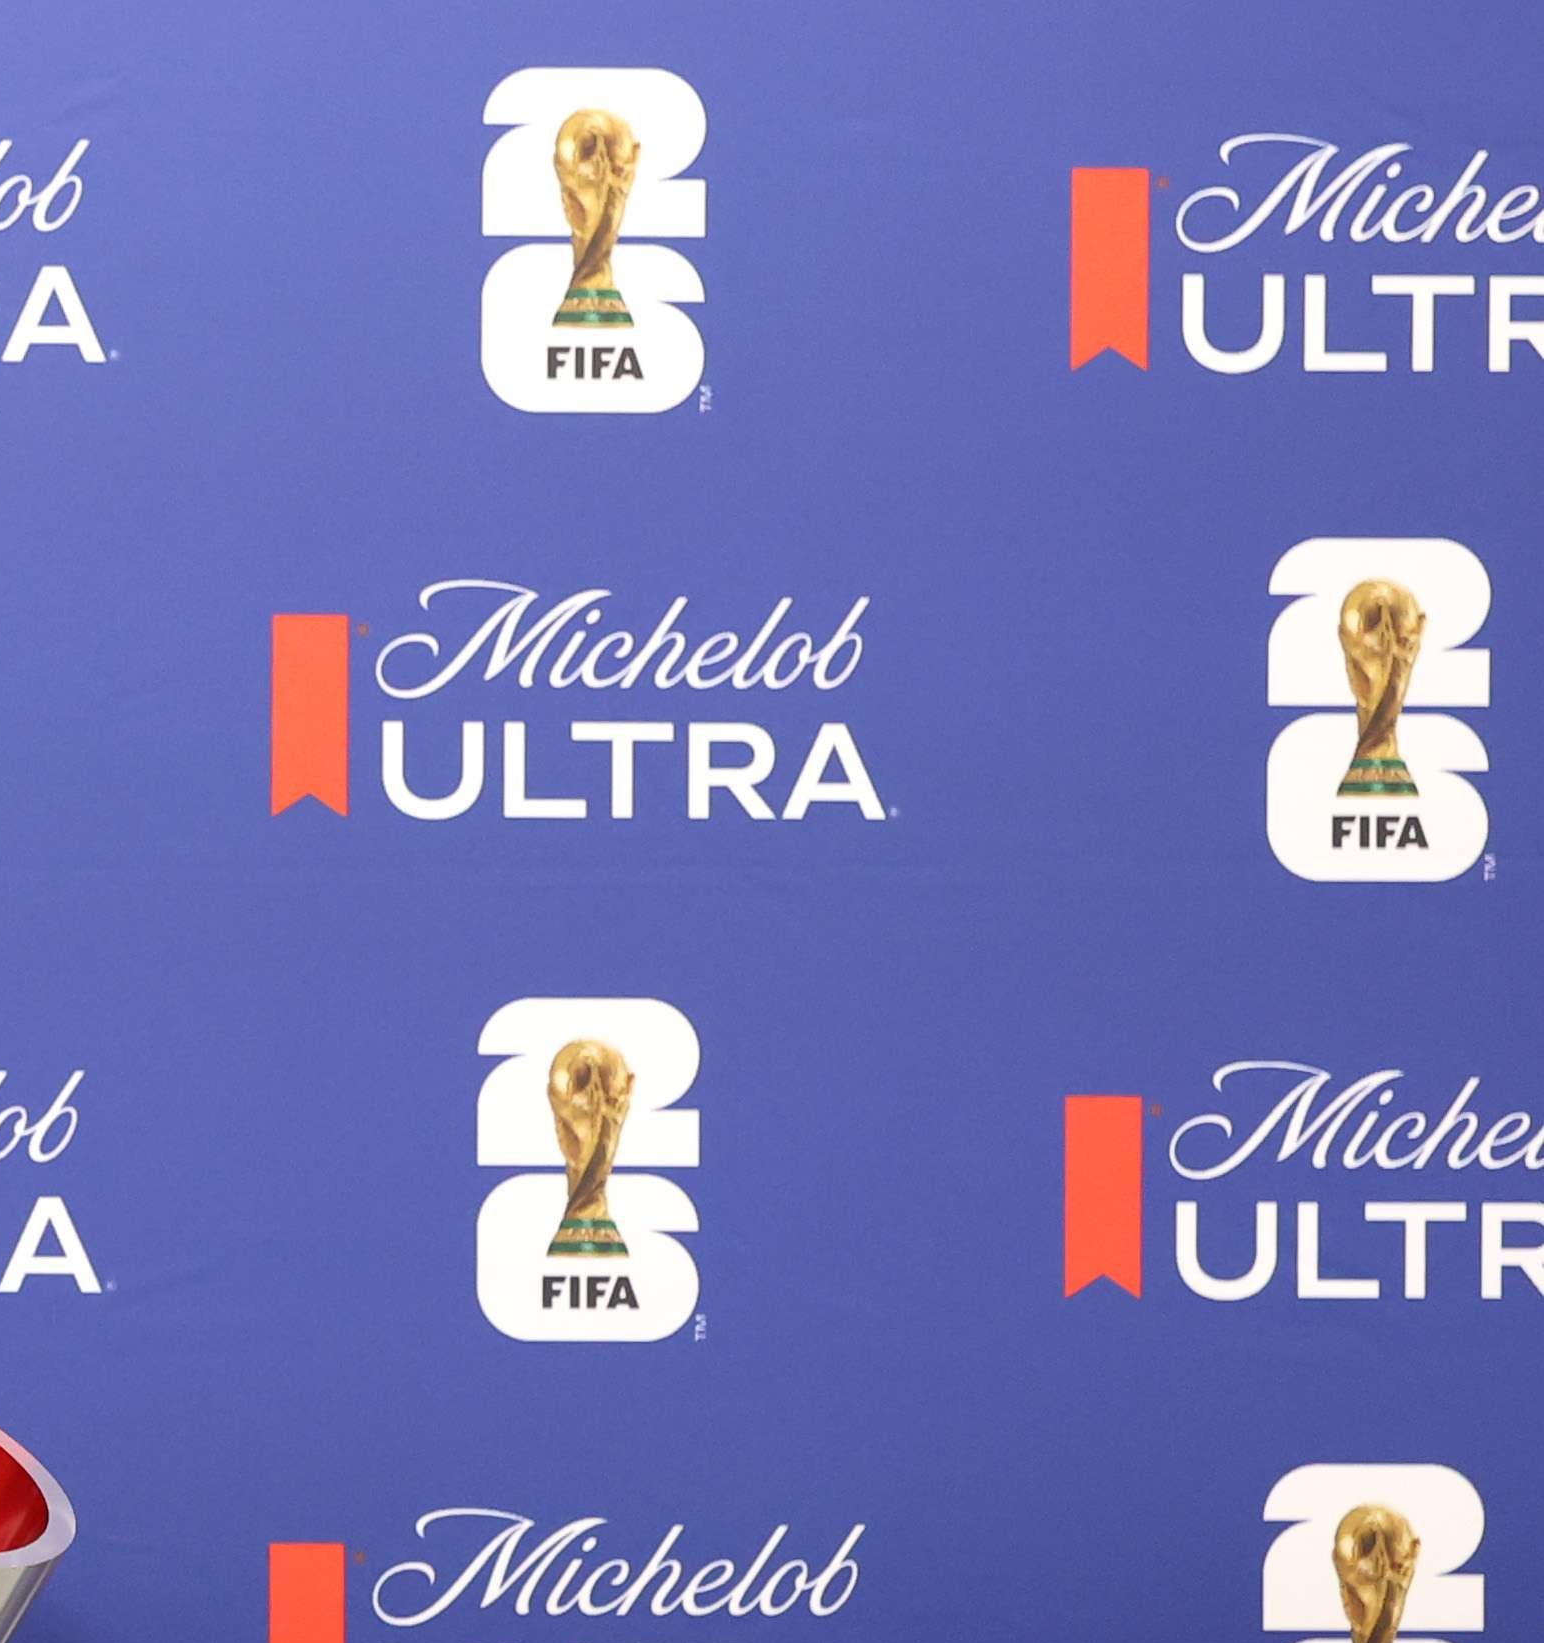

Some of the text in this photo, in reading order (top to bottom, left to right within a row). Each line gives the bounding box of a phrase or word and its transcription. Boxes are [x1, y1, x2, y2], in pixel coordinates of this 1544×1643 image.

[548, 348, 642, 378] FIFA
[375, 579, 870, 699] Michelob
[382, 720, 886, 820] ULTRA
[1333, 817, 1427, 847] FIFA
[543, 1277, 638, 1307] FIFA
[372, 1508, 865, 1626] Michelob
